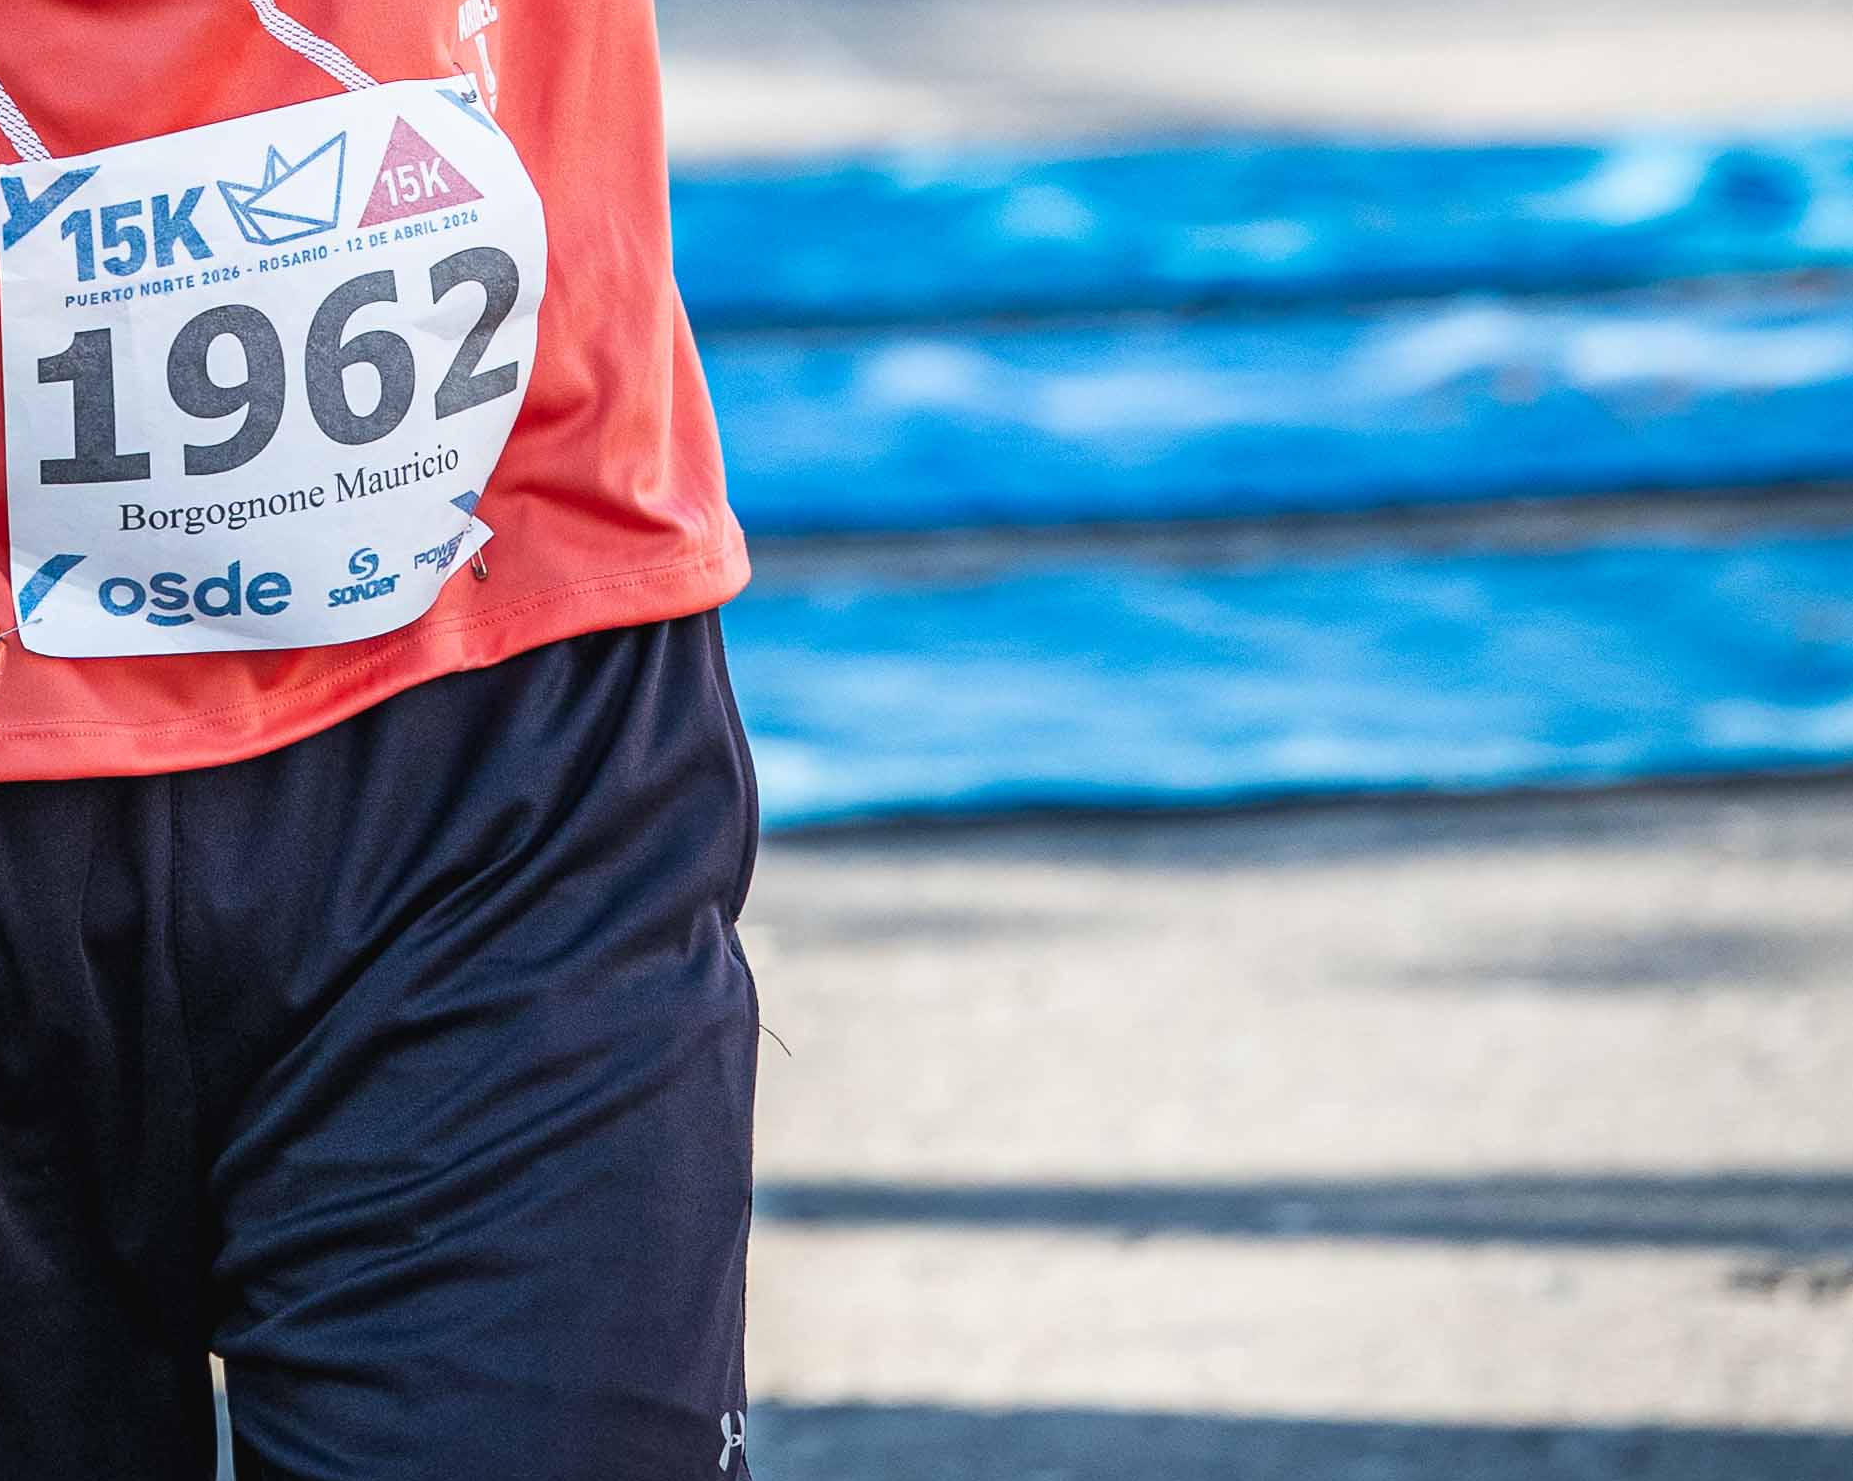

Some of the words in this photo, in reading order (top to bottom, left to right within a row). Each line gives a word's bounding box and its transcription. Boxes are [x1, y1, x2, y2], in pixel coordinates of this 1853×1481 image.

[380, 156, 452, 207] 15K
[60, 185, 214, 283] 15K
[64, 286, 135, 308] PUERTO
[140, 275, 196, 296] NORTE
[201, 264, 241, 285] 2026
[258, 247, 329, 273] ROSARIO
[346, 237, 364, 253] 12
[369, 231, 389, 248] DE
[393, 220, 439, 244] ABRIL
[442, 209, 479, 228] 2026
[36, 246, 520, 485] 1962
[119, 484, 326, 535] Borgognone
[334, 443, 460, 503] Mauricio
[98, 559, 293, 620] osde
